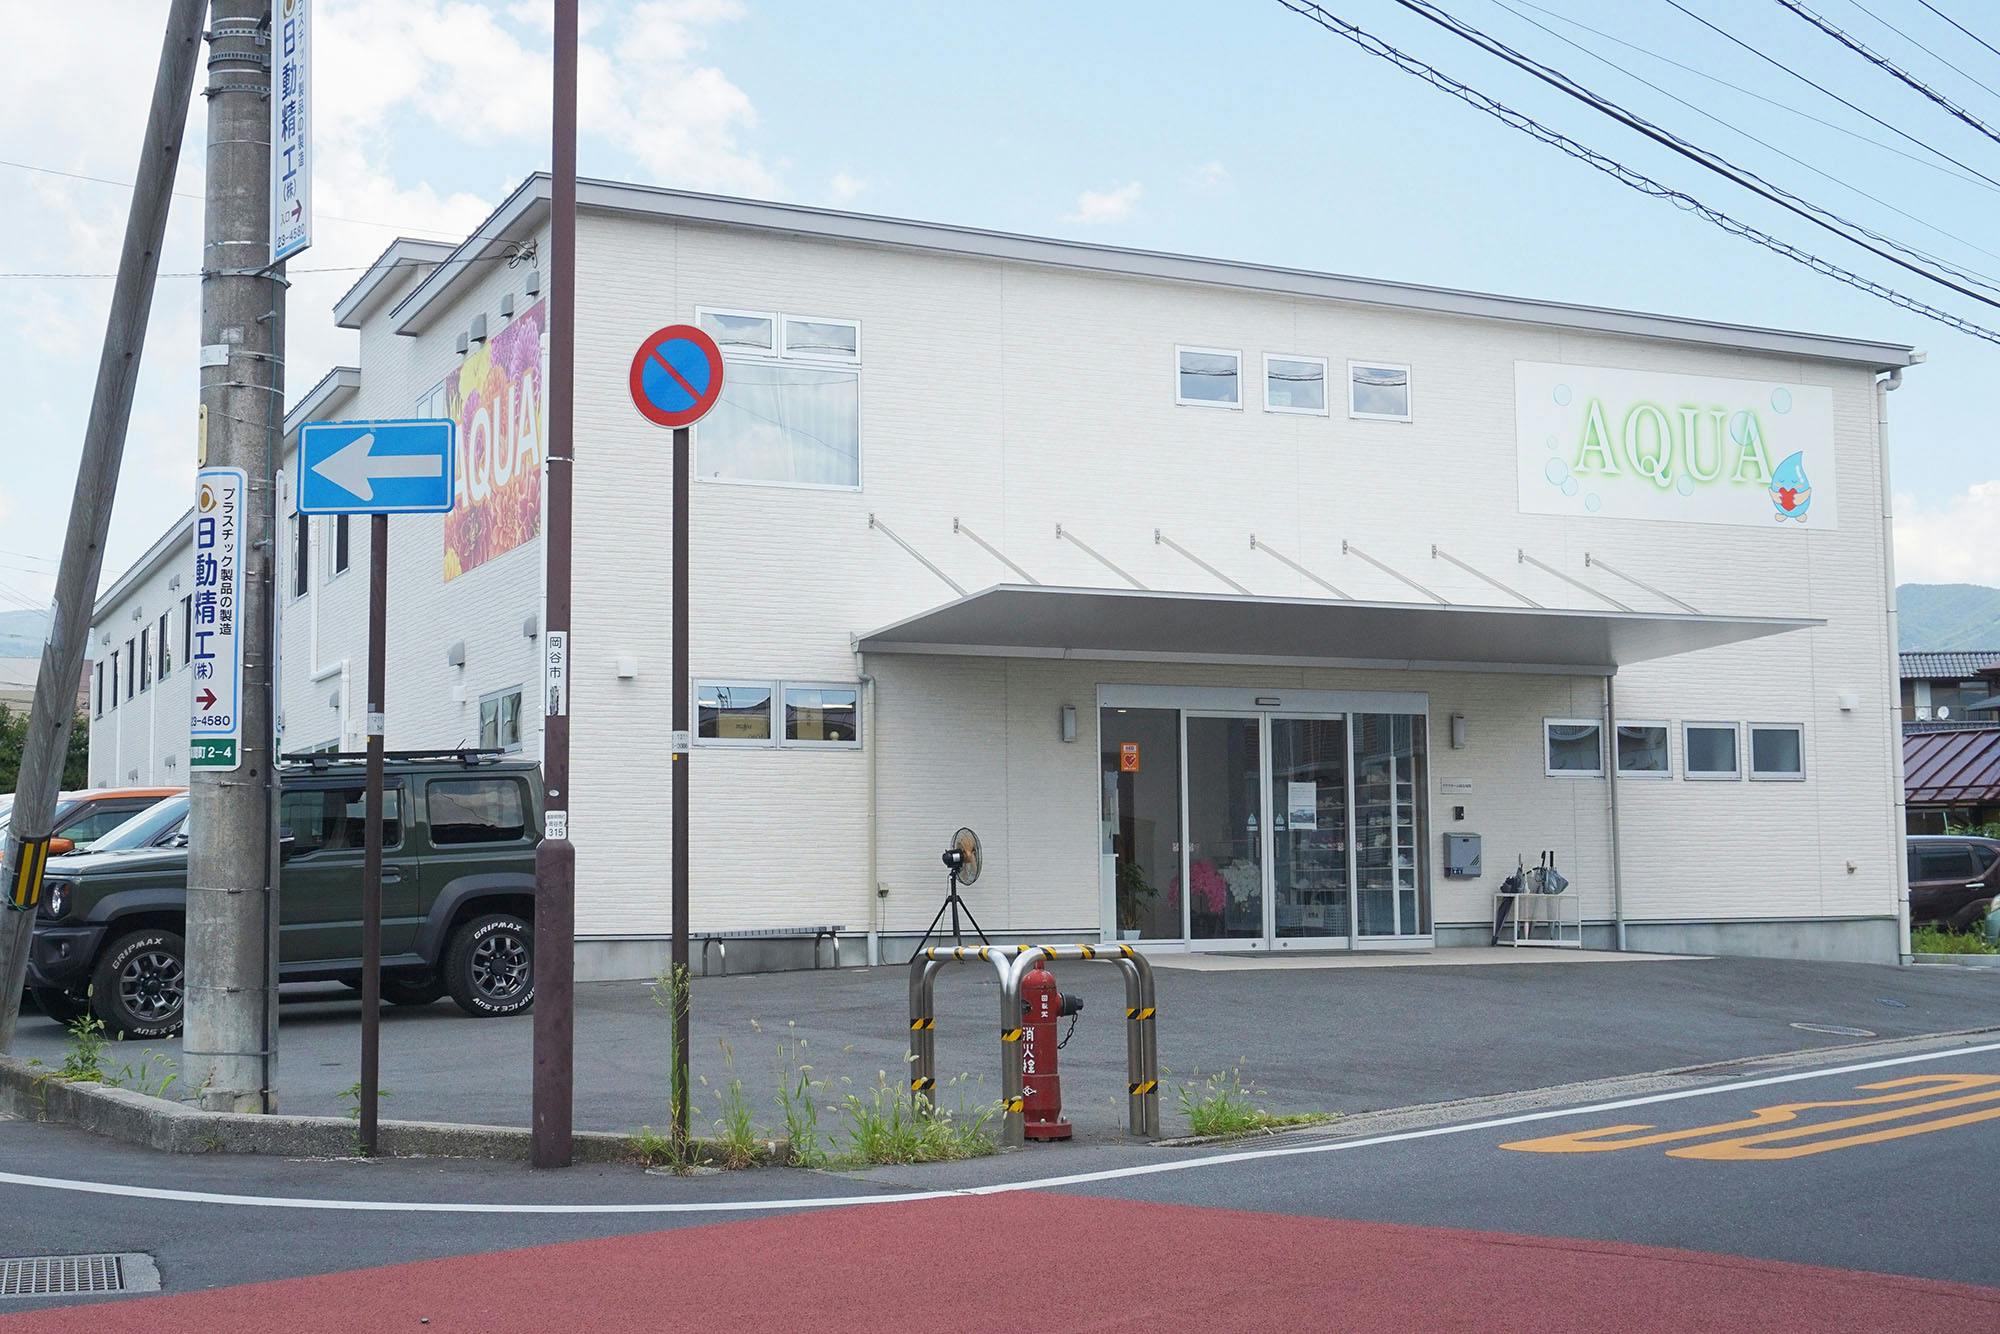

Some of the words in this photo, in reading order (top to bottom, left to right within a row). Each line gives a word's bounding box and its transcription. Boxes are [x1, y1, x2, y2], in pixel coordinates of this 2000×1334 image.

[1573, 397, 1773, 488] AQUA
[218, 487, 236, 636] プラスチック製品の製造
[549, 636, 562, 678] 岡谷市
[548, 828, 563, 837] 315
[474, 921, 522, 940] GRIPMAX
[112, 937, 163, 970] GRIPMAX
[1022, 1027, 1036, 1074] 消火栓
